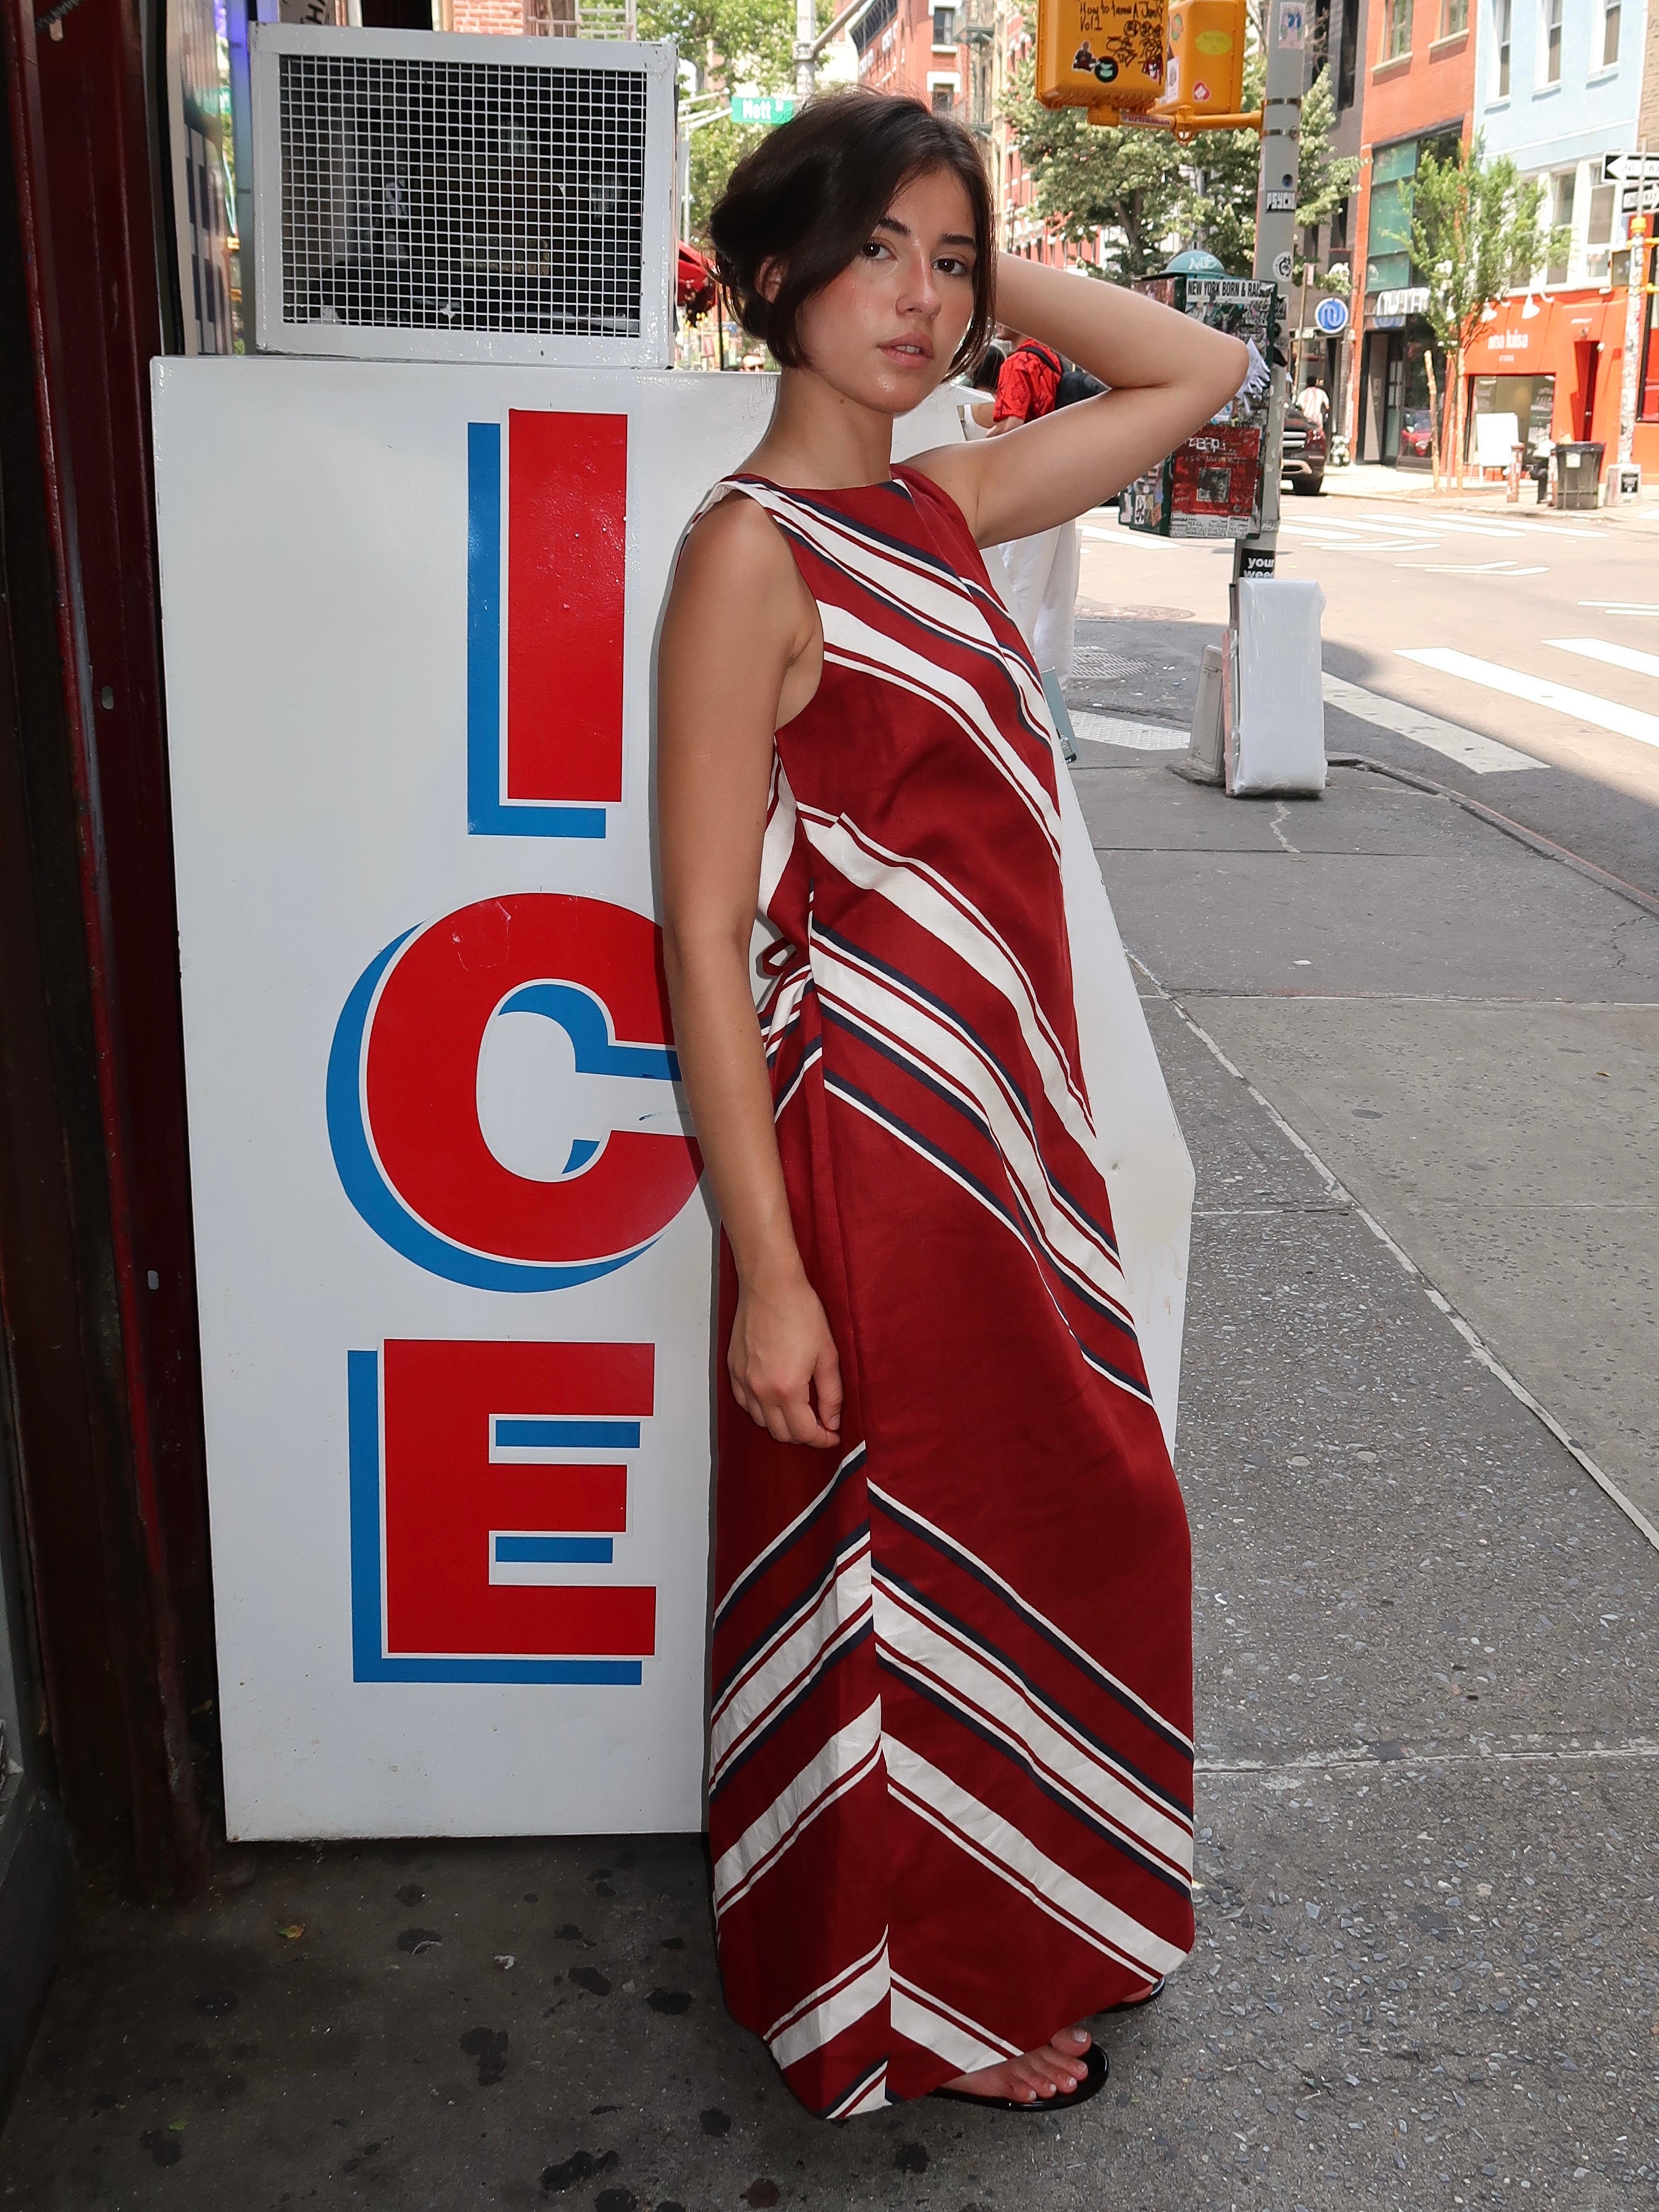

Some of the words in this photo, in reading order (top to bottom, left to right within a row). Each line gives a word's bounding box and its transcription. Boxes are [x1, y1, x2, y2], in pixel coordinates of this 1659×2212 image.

[742, 99, 772, 120] Mott
[1188, 280, 1203, 295] NEW
[1204, 281, 1221, 296] YORK
[1222, 281, 1240, 297] BORN
[1241, 282, 1246, 297] &
[1488, 334, 1505, 350] ana
[1506, 328, 1529, 349] luisa
[326, 409, 706, 1685] ICE
